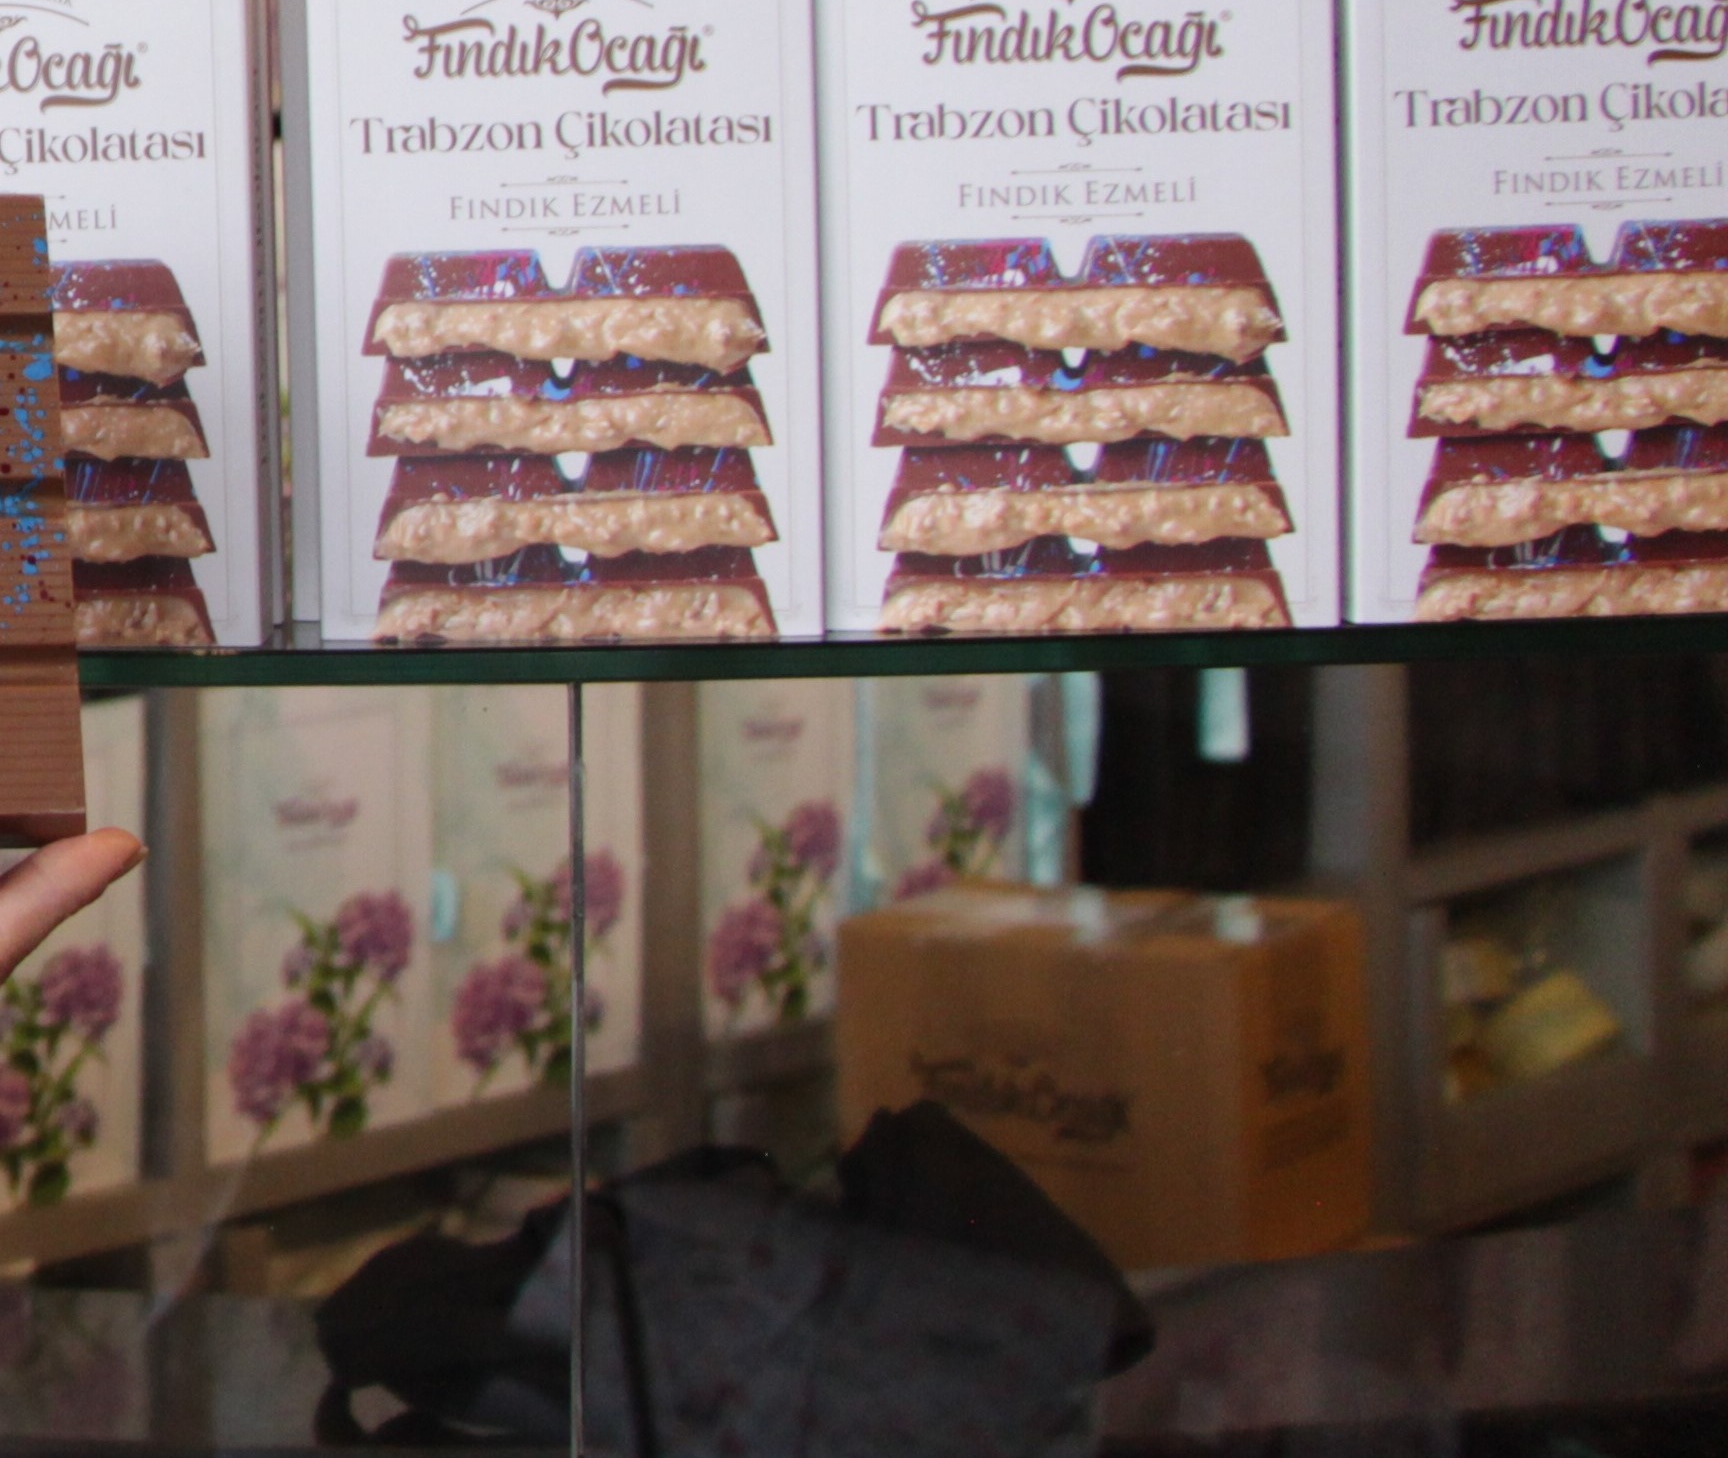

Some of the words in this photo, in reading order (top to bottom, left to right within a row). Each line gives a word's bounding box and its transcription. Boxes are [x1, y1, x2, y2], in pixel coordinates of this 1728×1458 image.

[856, 101, 1055, 142] Trabzon
[1067, 95, 1292, 148] Çikolatası
[1395, 88, 1589, 128] Trabzon
[1599, 81, 1728, 133] Çikola
[349, 115, 543, 155] Trabzon
[554, 109, 774, 161] Çikolatası
[958, 183, 1072, 209] FINDIK
[1085, 176, 1197, 205] EZMELİ
[1494, 169, 1605, 195] FINDIK
[1616, 161, 1723, 191] EZMELİ
[47, 204, 118, 232] MELİ
[449, 195, 560, 221] FINDIK
[573, 188, 682, 217] EZMELİ
